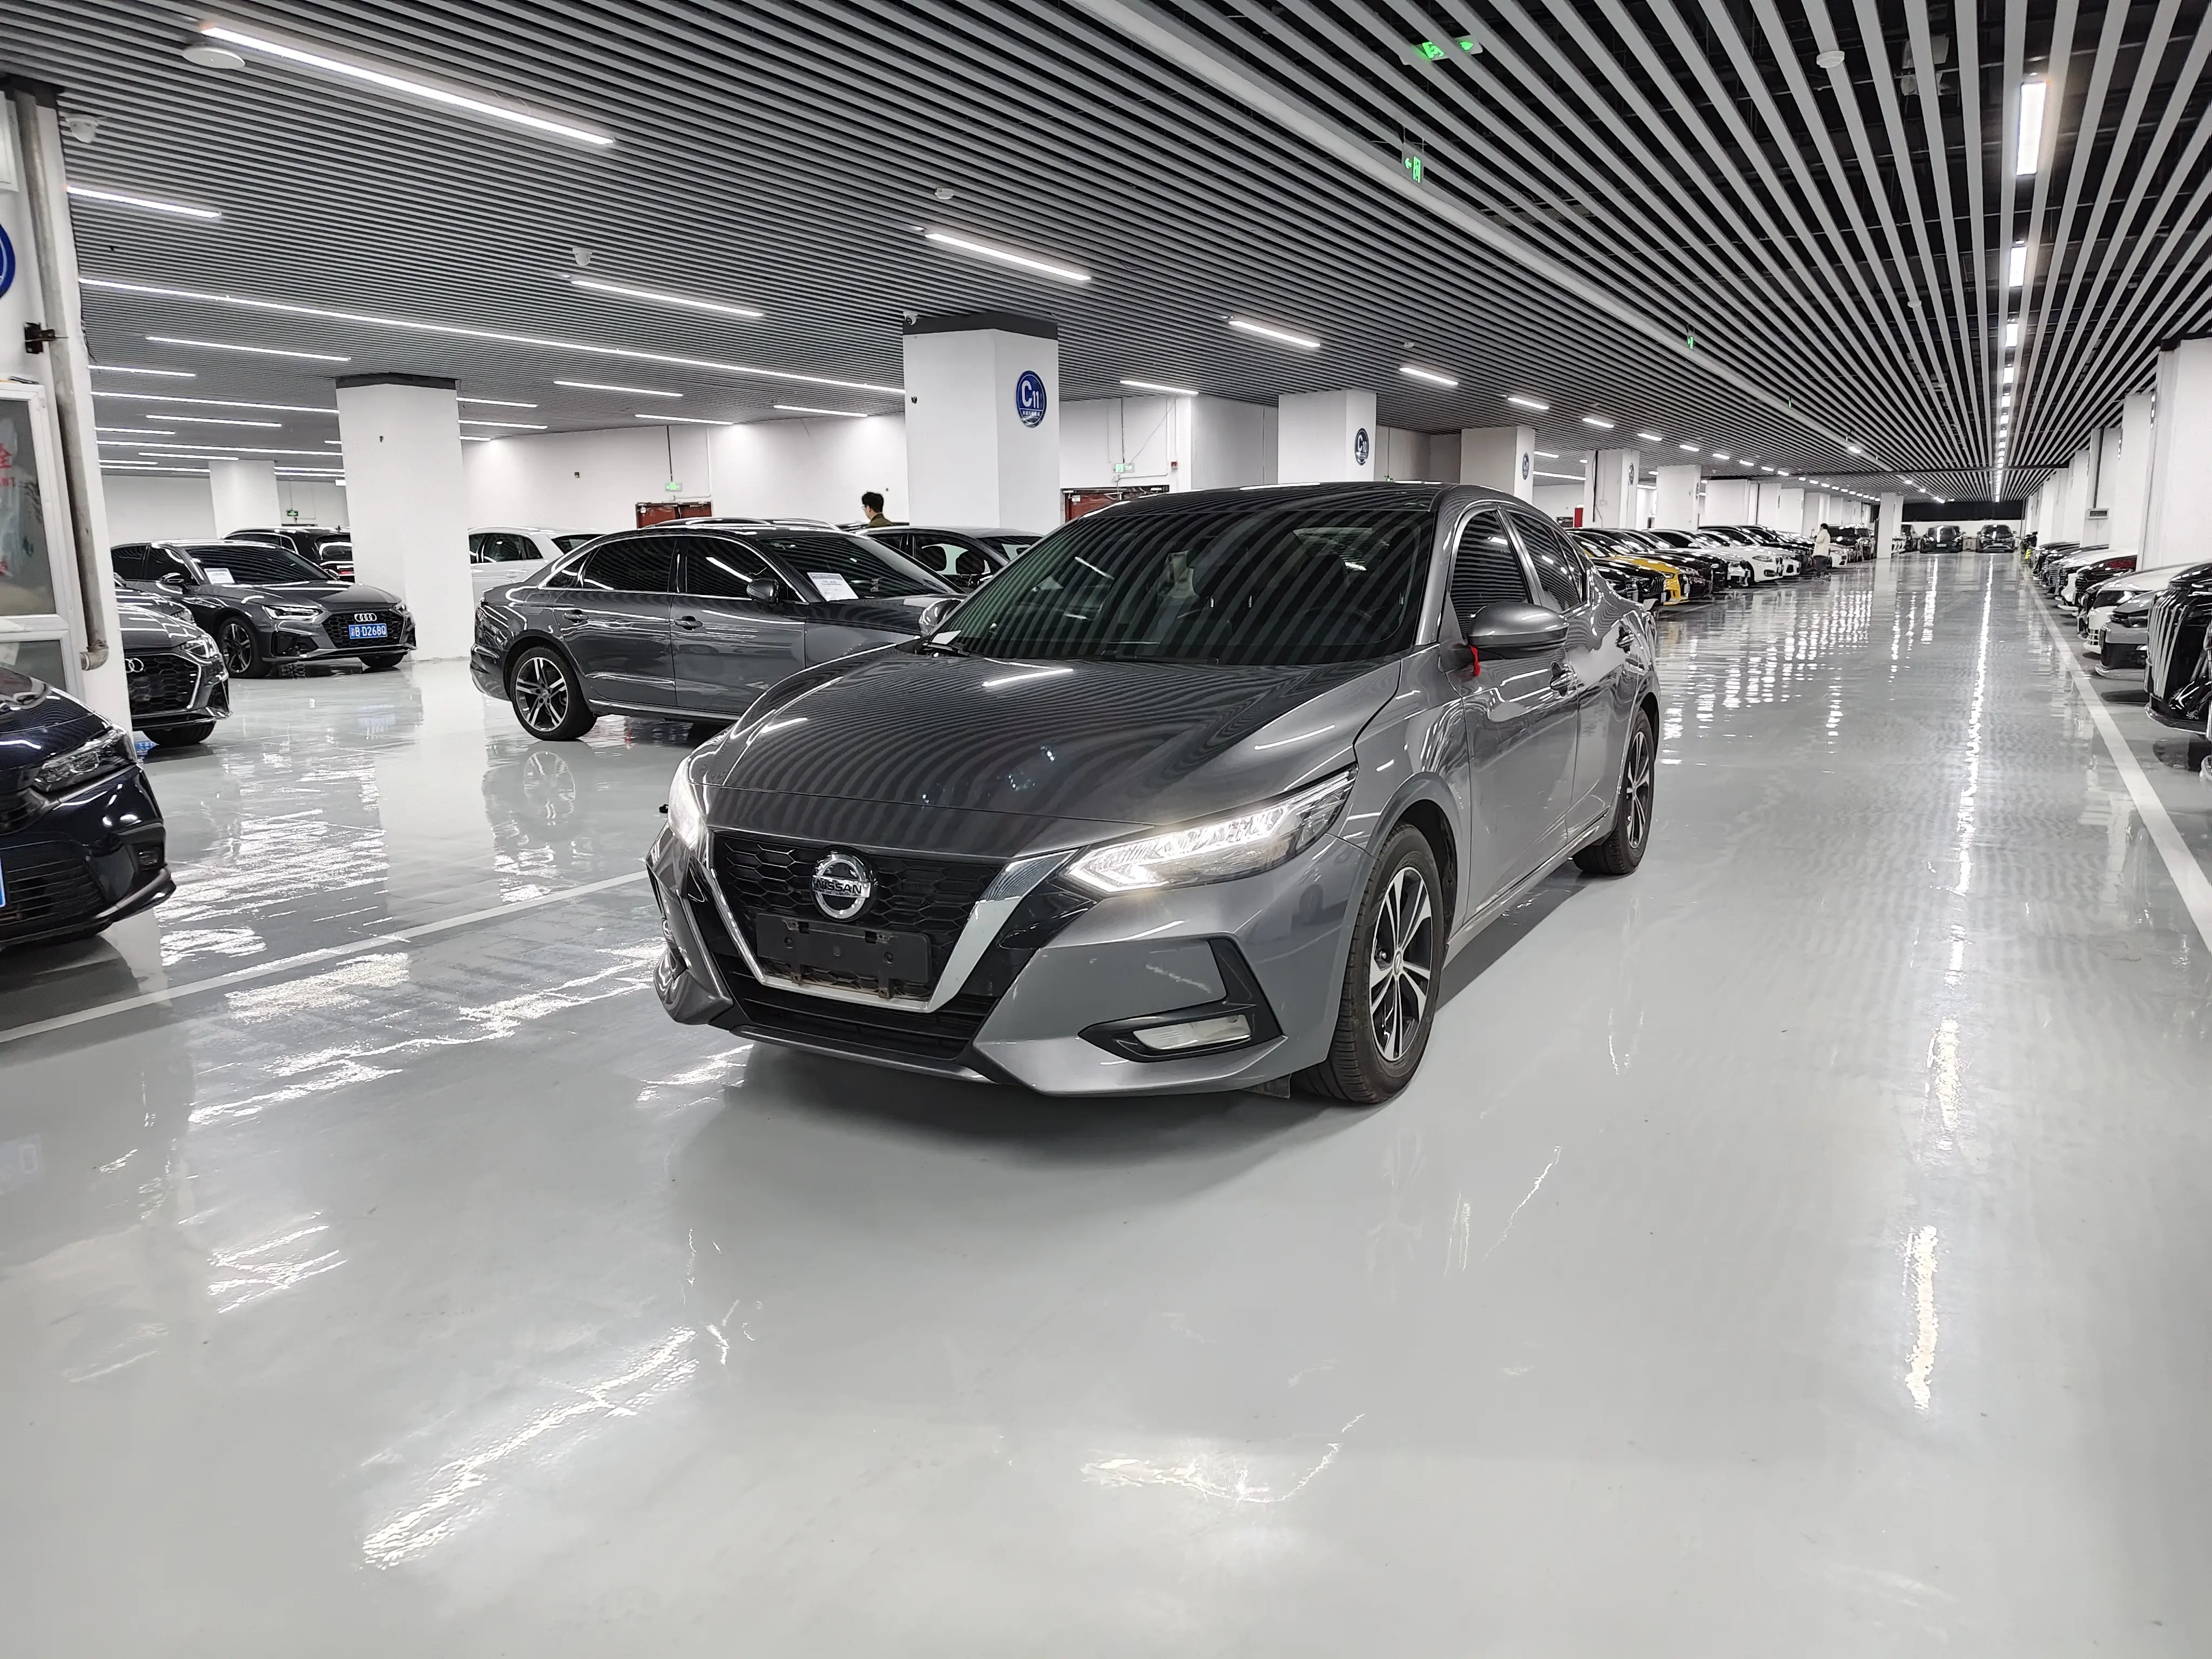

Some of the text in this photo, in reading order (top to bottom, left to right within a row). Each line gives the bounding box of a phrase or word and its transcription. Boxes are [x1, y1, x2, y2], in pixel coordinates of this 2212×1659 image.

[1021, 380, 1040, 409] C11
[1357, 434, 1367, 453] C10
[814, 878, 862, 894] NISSAN
